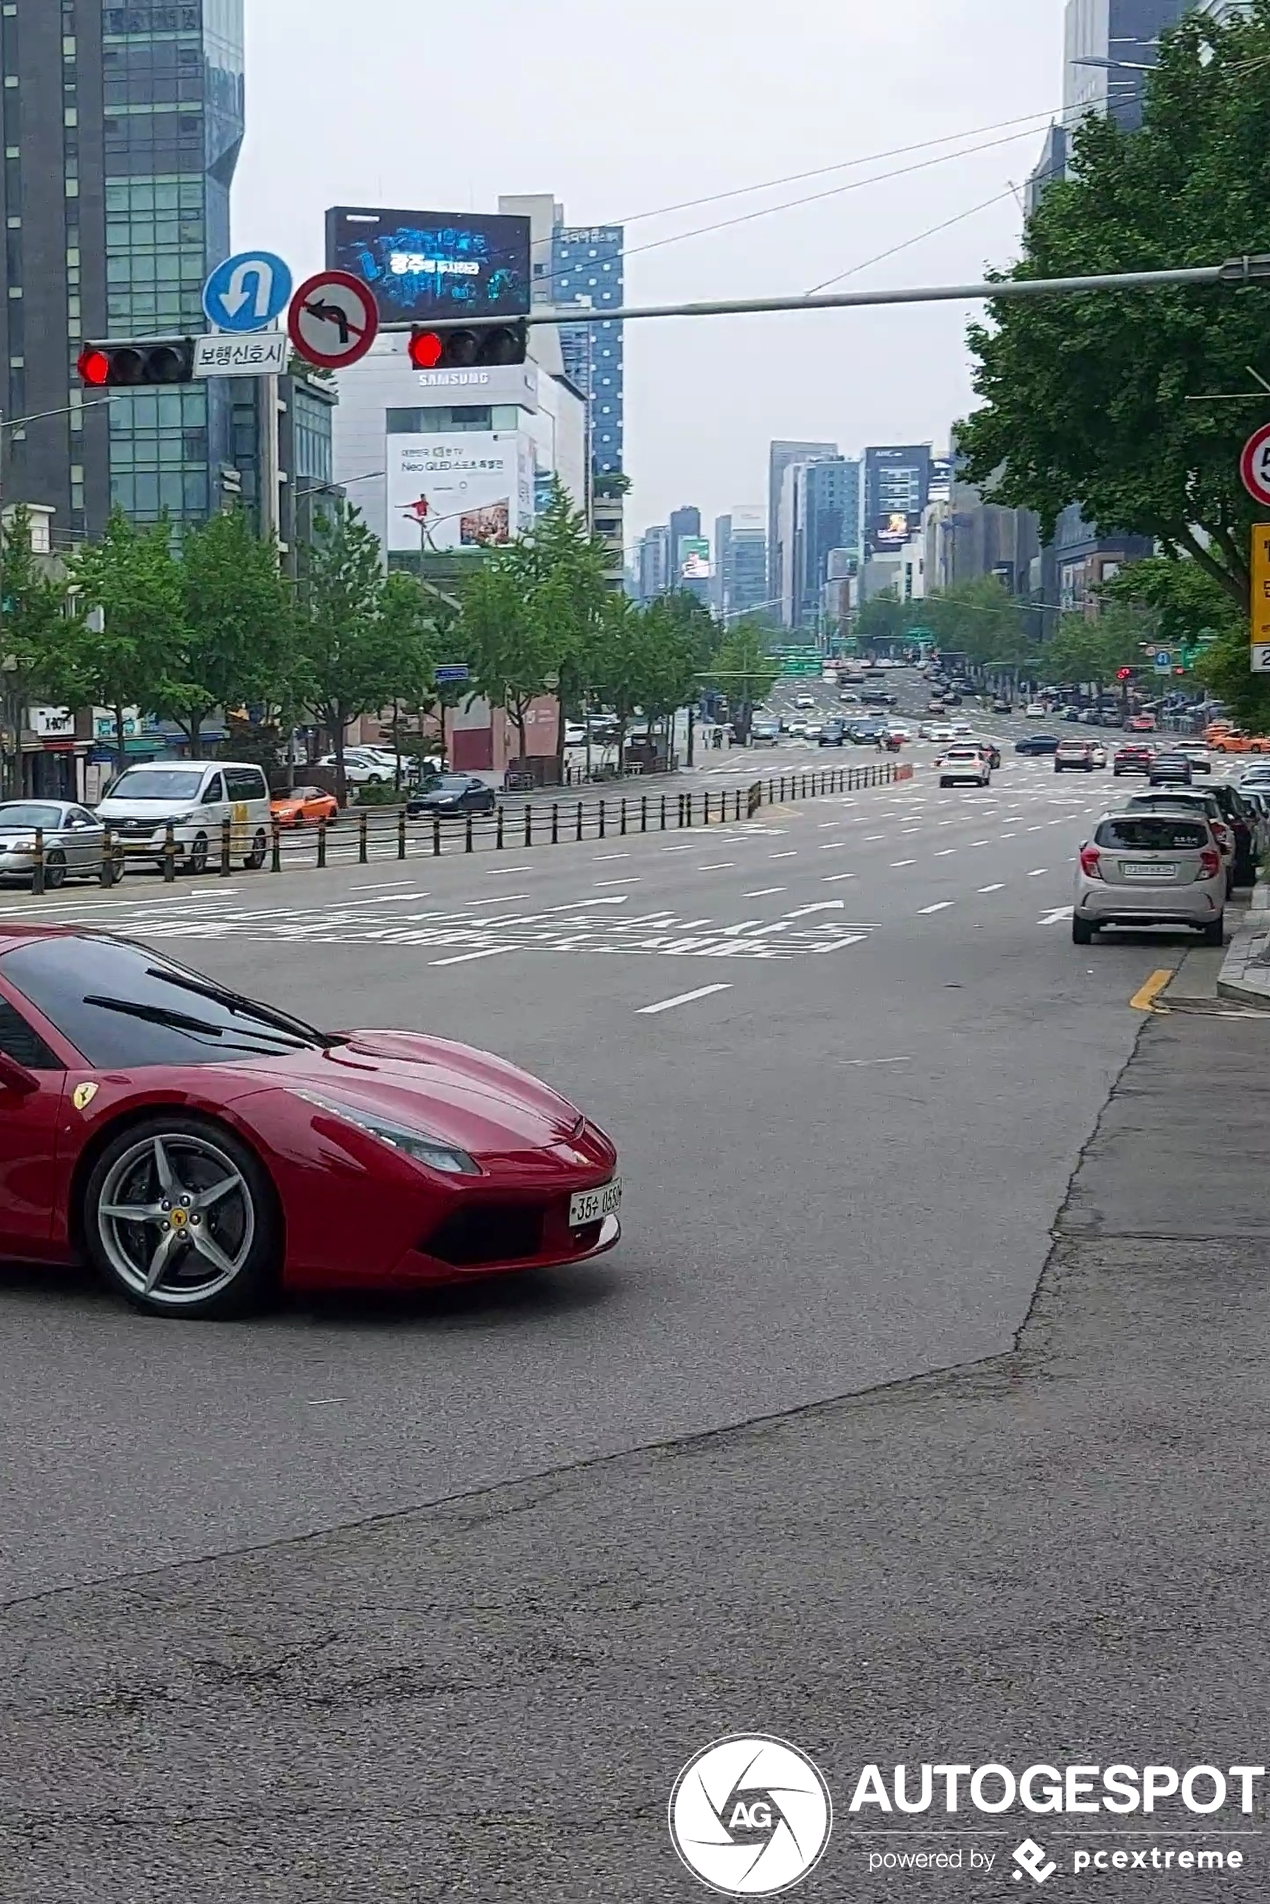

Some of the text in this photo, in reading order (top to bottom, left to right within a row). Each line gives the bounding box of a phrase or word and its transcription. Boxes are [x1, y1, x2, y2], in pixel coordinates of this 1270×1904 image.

[199, 344, 282, 366] 보행신호시
[418, 372, 489, 387] SAMSUNG
[401, 461, 424, 472] Neo
